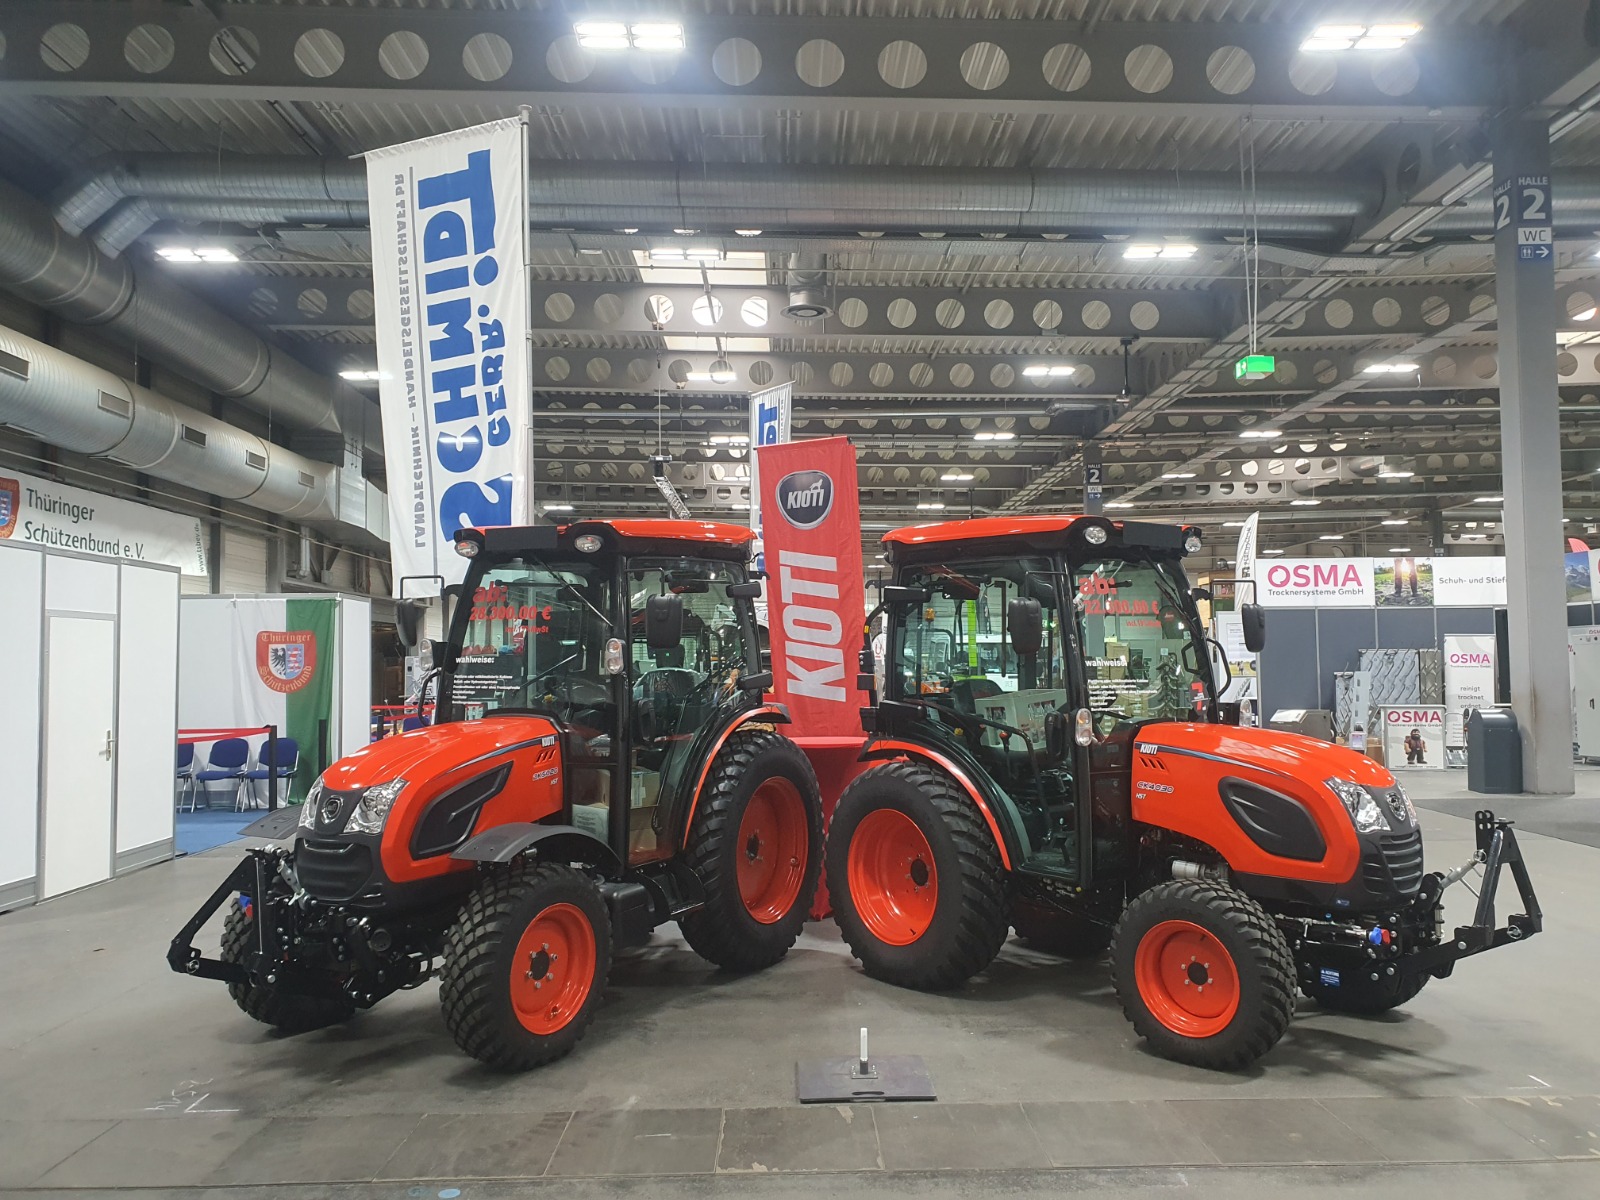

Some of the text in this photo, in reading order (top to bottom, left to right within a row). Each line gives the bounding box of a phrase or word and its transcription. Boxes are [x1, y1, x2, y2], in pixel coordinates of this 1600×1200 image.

[1494, 180, 1511, 198] HALLE
[1518, 176, 1548, 186] HALLE
[1496, 195, 1510, 230] 2
[1522, 188, 1546, 220] 2
[1523, 230, 1546, 242] WC
[1090, 469, 1100, 482] 2
[26, 488, 94, 524] Thüringer
[787, 488, 824, 510] KIOTI
[24, 521, 120, 556] Schützenbund
[124, 544, 134, 558] e.
[136, 542, 144, 560] V.
[1078, 572, 1118, 595] ab:
[1268, 564, 1362, 588] OSMA
[472, 581, 508, 603] ab:
[1268, 588, 1364, 598] Trocknersysteme GmbH
[470, 605, 552, 621] 28.300,00 €
[1151, 600, 1160, 614] €
[778, 550, 846, 702] KIOTI
[1450, 654, 1490, 664] OSMA
[1388, 711, 1442, 723] OSMA
[1140, 743, 1158, 754] KIOTI
